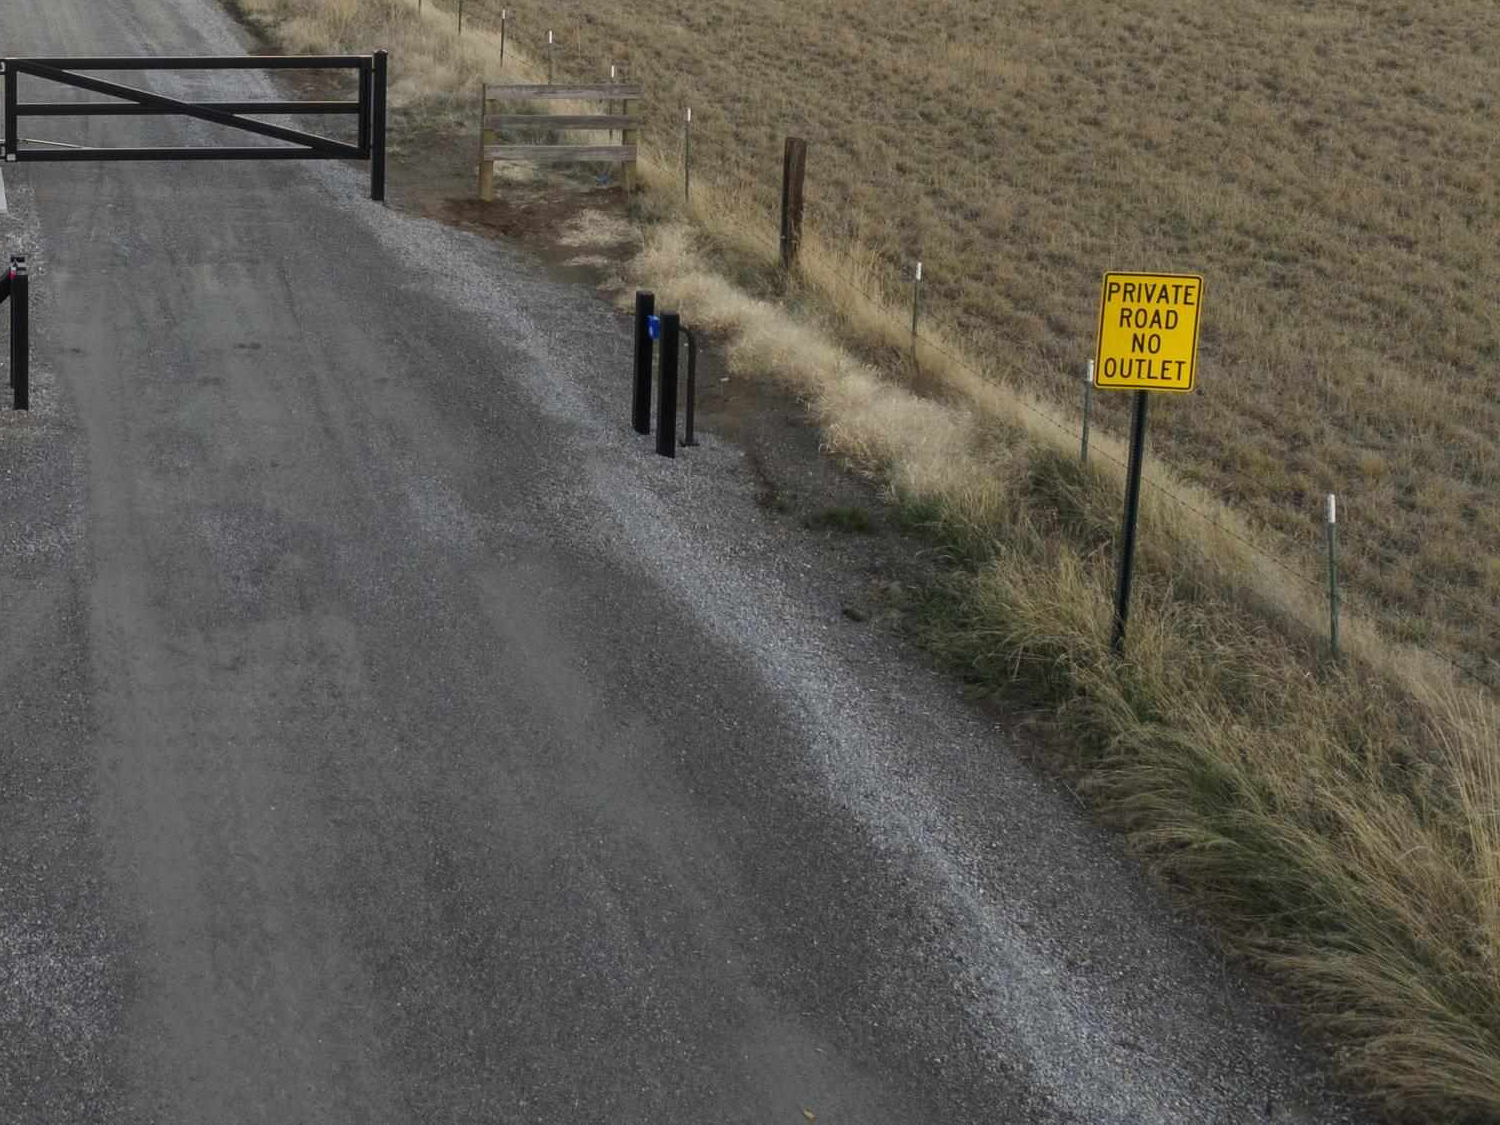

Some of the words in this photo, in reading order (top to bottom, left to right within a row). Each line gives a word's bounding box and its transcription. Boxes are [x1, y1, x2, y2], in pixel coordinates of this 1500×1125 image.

[1107, 282, 1196, 305] PRIVATE
[1119, 308, 1178, 330] ROAD
[1131, 333, 1161, 354] NO
[1104, 357, 1186, 381] OUTLET
